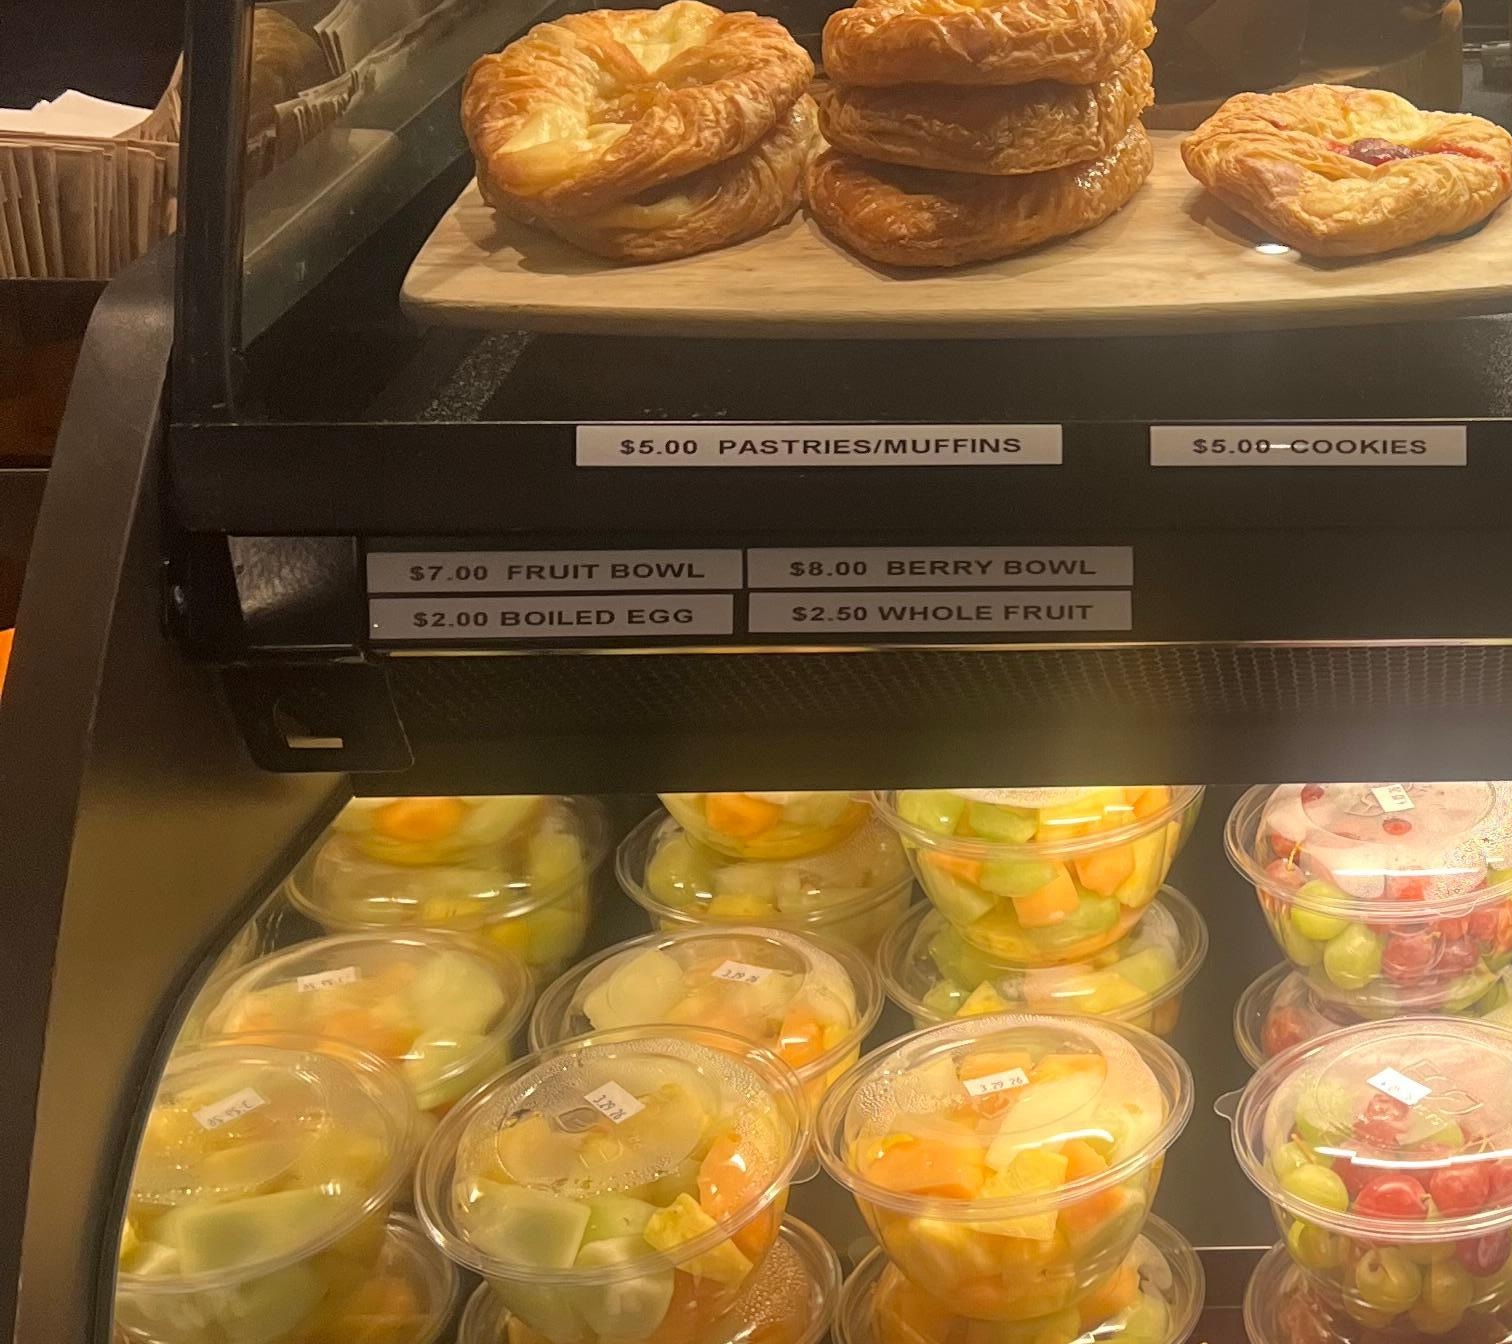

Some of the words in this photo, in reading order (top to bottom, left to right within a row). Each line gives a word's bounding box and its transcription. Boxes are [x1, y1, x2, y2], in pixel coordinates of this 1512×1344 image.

[619, 439, 698, 456] $5.00
[719, 438, 1022, 455] PASTRIES/MUFFINS
[1192, 438, 1271, 455] $5.00
[1290, 439, 1427, 455] COOKIES
[409, 565, 488, 582] $7.00
[507, 563, 600, 581] FRUIT
[610, 562, 705, 579] BOWL
[789, 561, 867, 577] $8.00
[886, 559, 993, 576] BERRY
[1004, 559, 1097, 575] BOWL
[413, 611, 489, 628] $2.00
[500, 609, 616, 627] BOILED
[627, 608, 693, 625] EGG
[792, 606, 868, 622] $2.50
[877, 605, 993, 621] WHOLE
[1003, 604, 1094, 621] FRUIT
